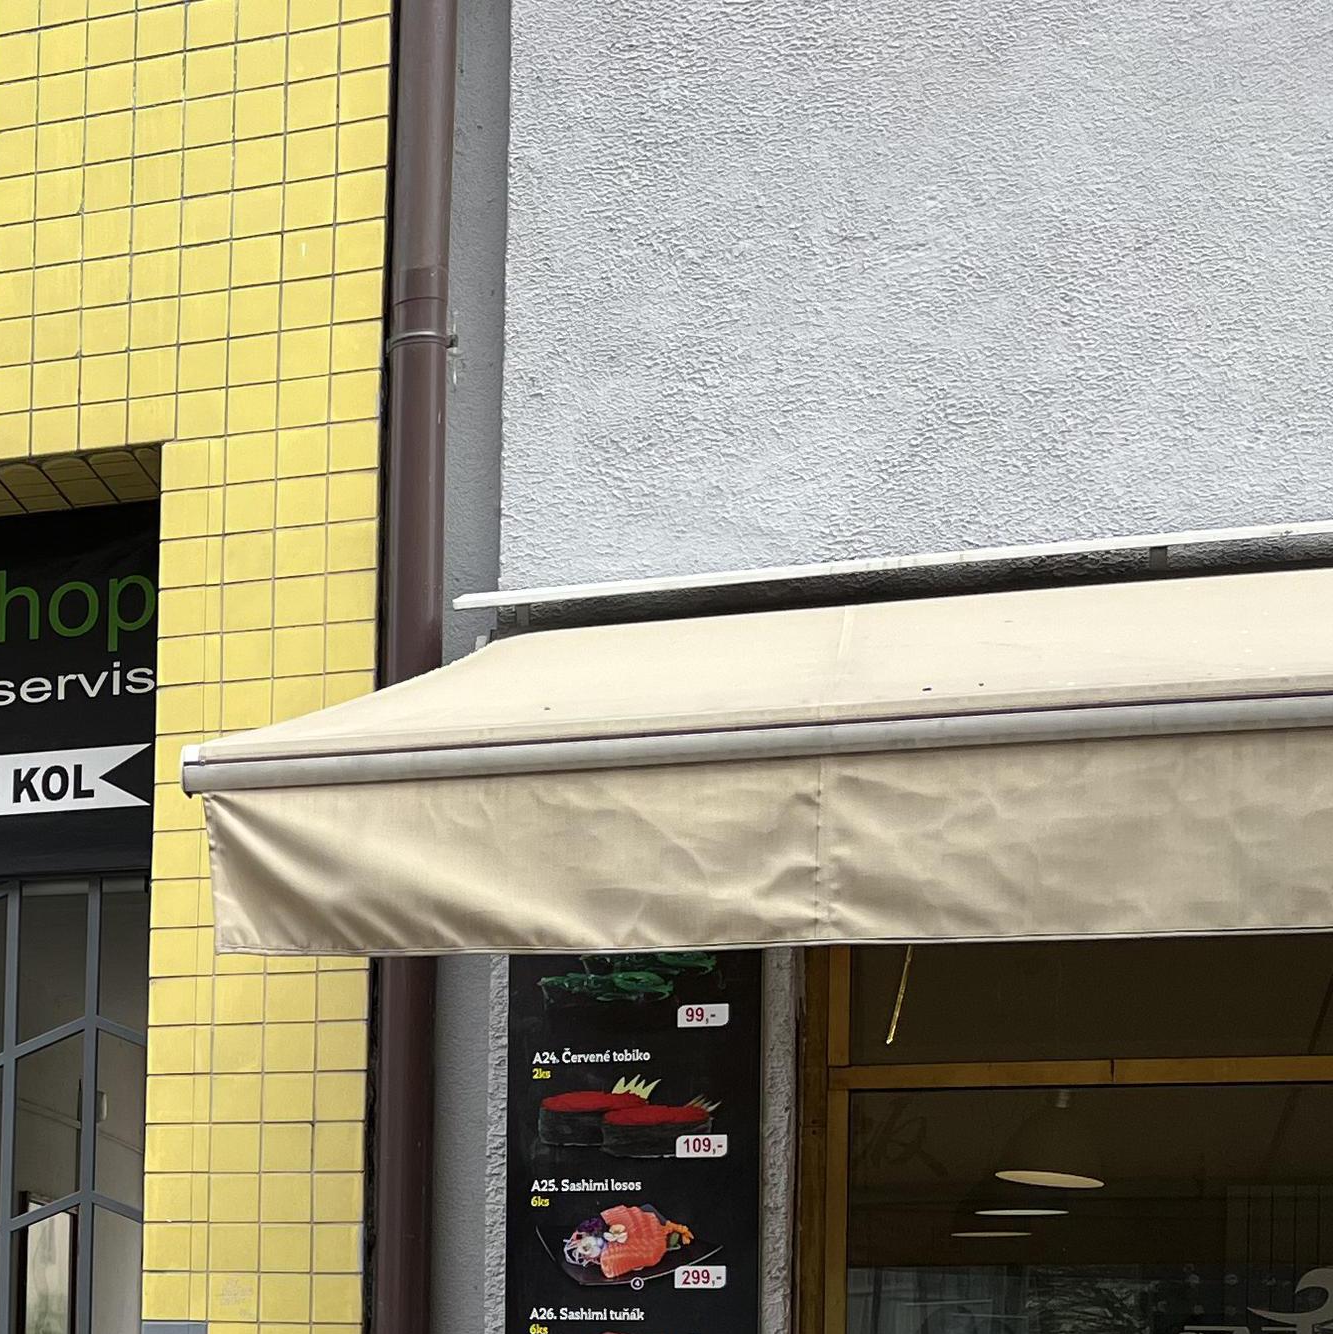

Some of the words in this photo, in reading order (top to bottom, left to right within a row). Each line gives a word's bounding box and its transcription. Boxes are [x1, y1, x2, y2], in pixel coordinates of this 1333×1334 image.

[12, 763, 96, 803] KOL
[685, 1006, 716, 1025] 99,-
[532, 1051, 560, 1065] A24.
[562, 1048, 611, 1064] Červené
[612, 1049, 651, 1063] tobiko
[683, 1137, 723, 1156] 109,-
[531, 1179, 559, 1193] A25.
[561, 1178, 609, 1192] Sashimi
[610, 1179, 642, 1192] losos
[682, 1269, 723, 1288] 299,-
[529, 1307, 558, 1321] A26.
[559, 1307, 608, 1321] Sashimi
[609, 1308, 645, 1322] tuňák
